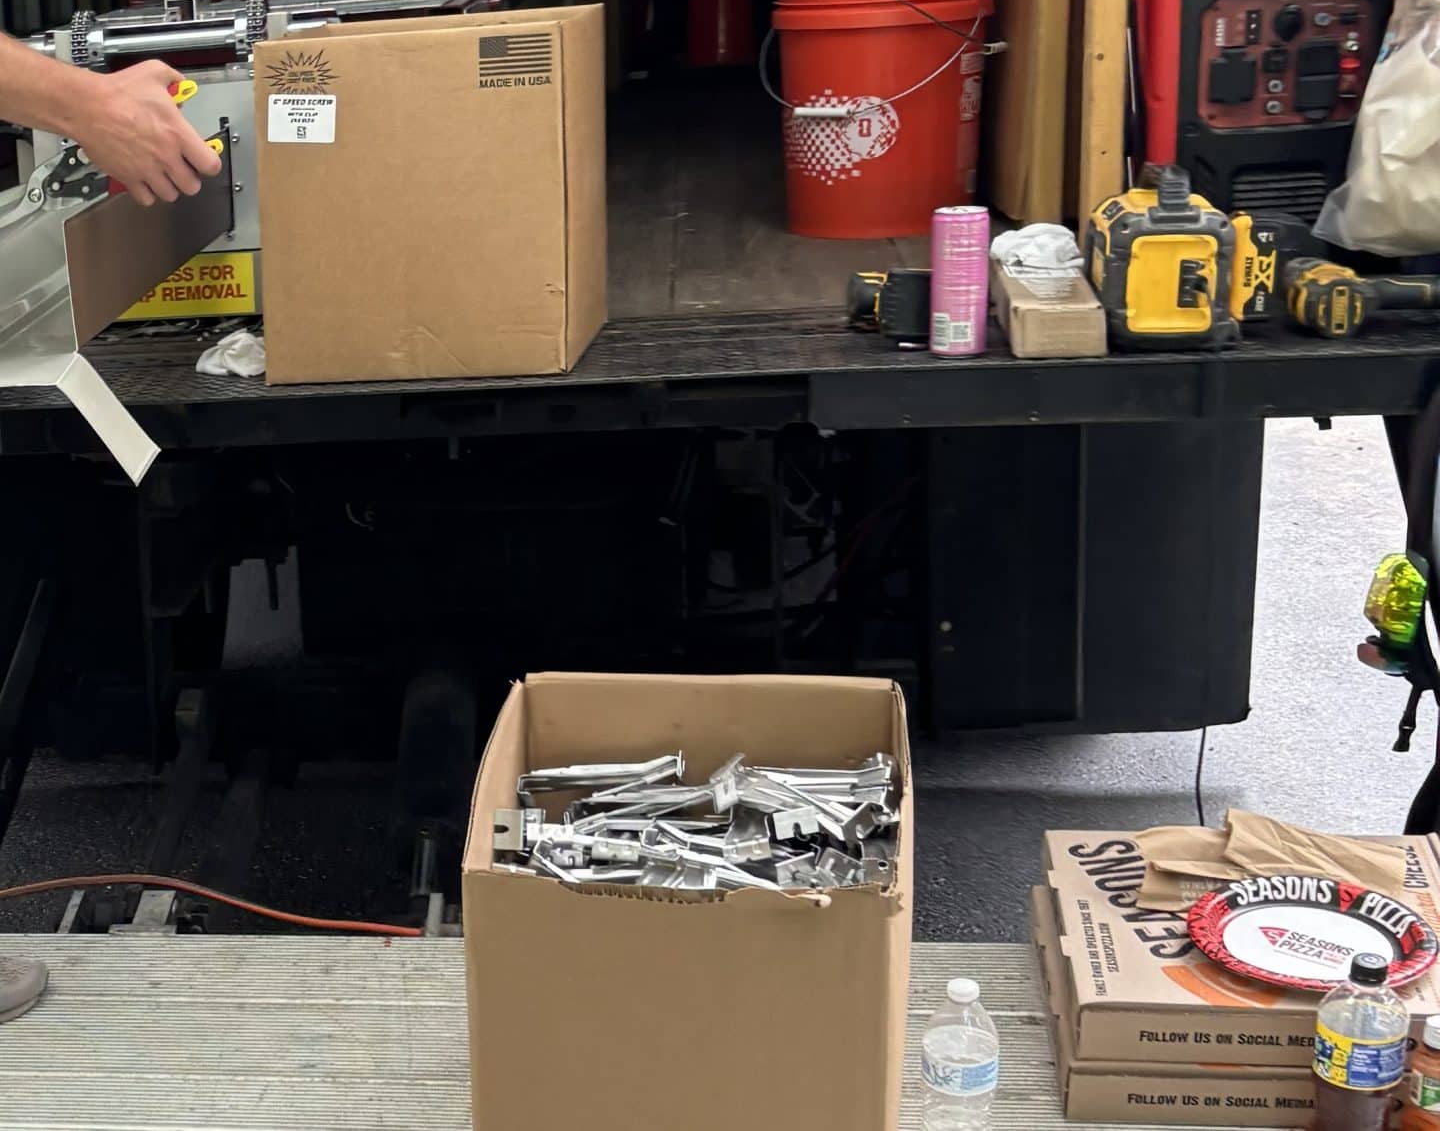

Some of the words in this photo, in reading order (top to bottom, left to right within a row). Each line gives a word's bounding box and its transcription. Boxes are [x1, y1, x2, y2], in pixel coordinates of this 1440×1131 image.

[479, 77, 512, 88] MADE
[513, 77, 525, 86] IN
[528, 75, 552, 86] USA
[199, 265, 235, 281] FOR
[162, 282, 248, 302] REMOVAL
[1229, 875, 1335, 906] SEASONS
[1359, 892, 1418, 939] PIZZA
[1278, 939, 1324, 959] PIZZA
[1287, 931, 1355, 956] SEASONS
[1139, 1030, 1189, 1043] FOLLOW
[1193, 1032, 1211, 1044] US
[1216, 1033, 1233, 1045] ON
[1237, 1033, 1281, 1047] SOCIAL
[1287, 1035, 1315, 1047] MED
[1127, 1093, 1177, 1106] FOLLOW
[1182, 1095, 1199, 1106] US
[1204, 1095, 1221, 1106] ON
[1225, 1096, 1269, 1108] SOCIAL
